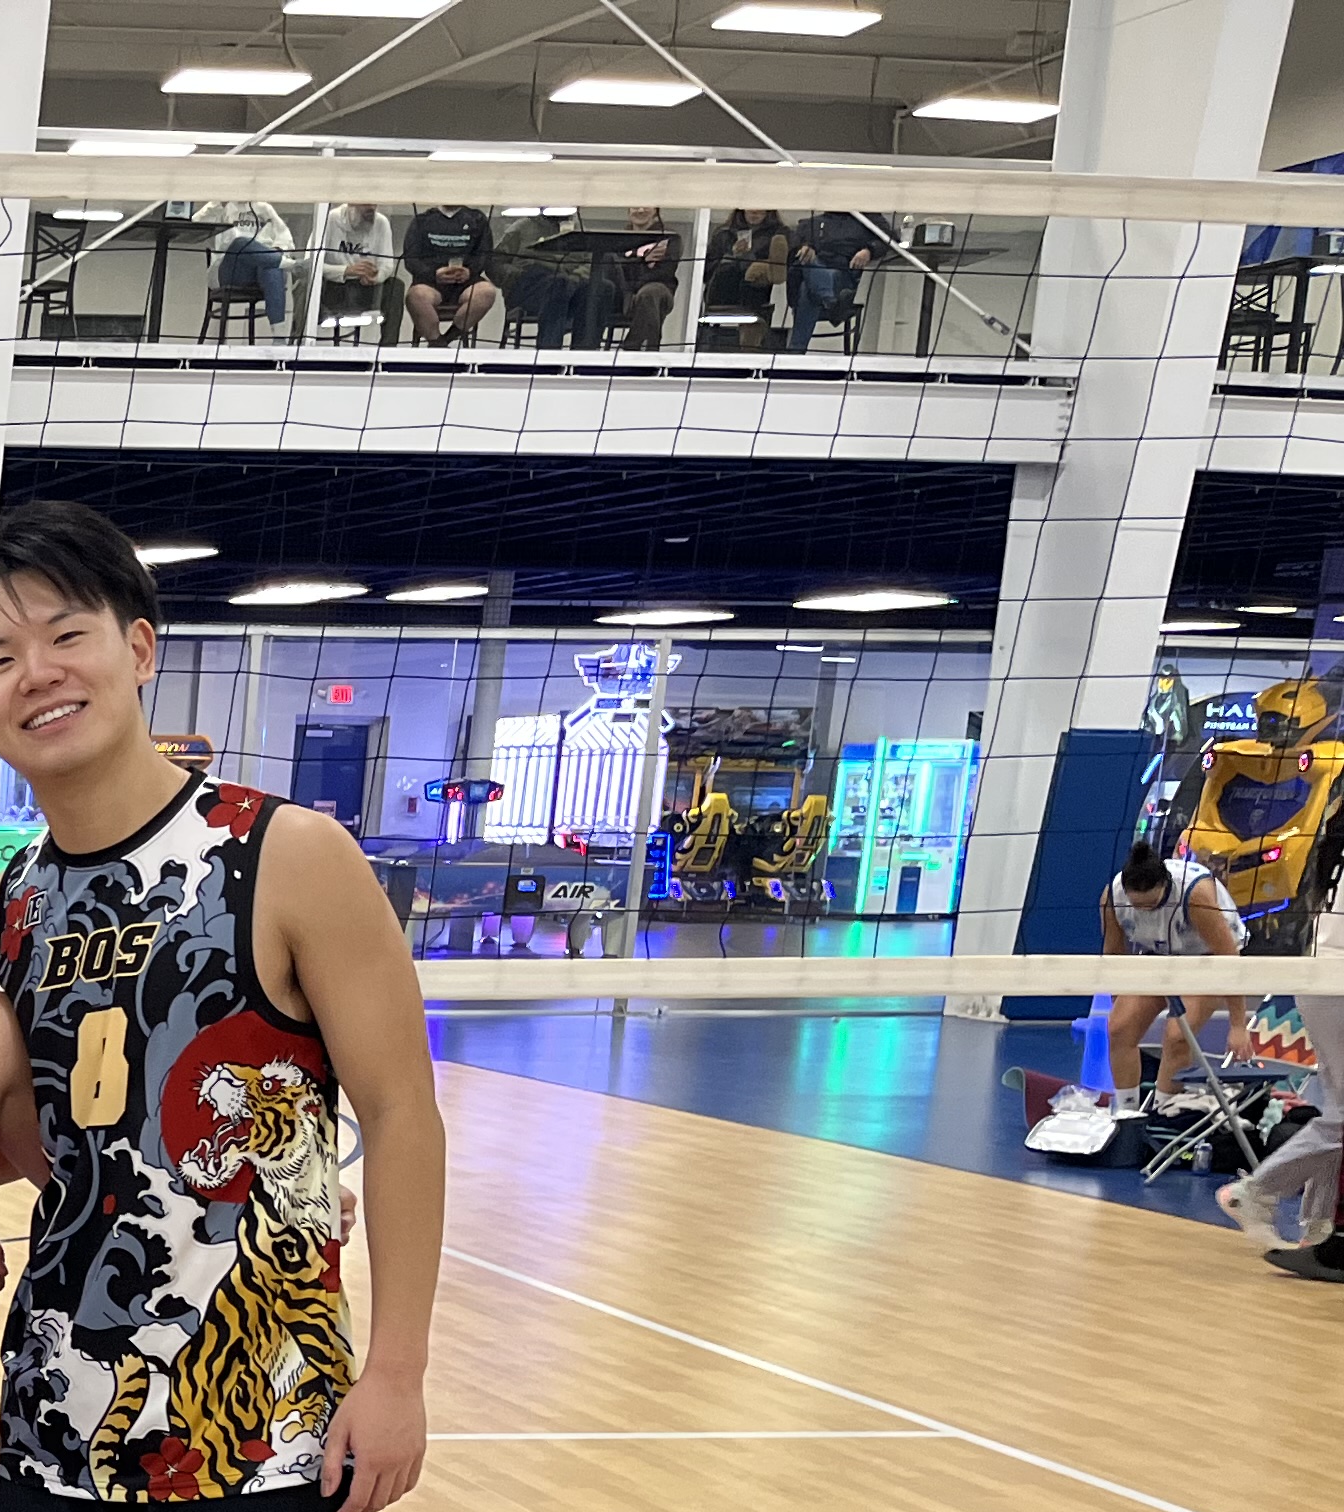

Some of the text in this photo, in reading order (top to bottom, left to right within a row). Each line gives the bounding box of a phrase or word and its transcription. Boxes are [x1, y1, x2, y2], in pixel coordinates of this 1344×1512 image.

[1206, 702, 1257, 718] HAL
[551, 884, 594, 899] AIR
[36, 921, 161, 992] BOS
[70, 1006, 129, 1129] 8
